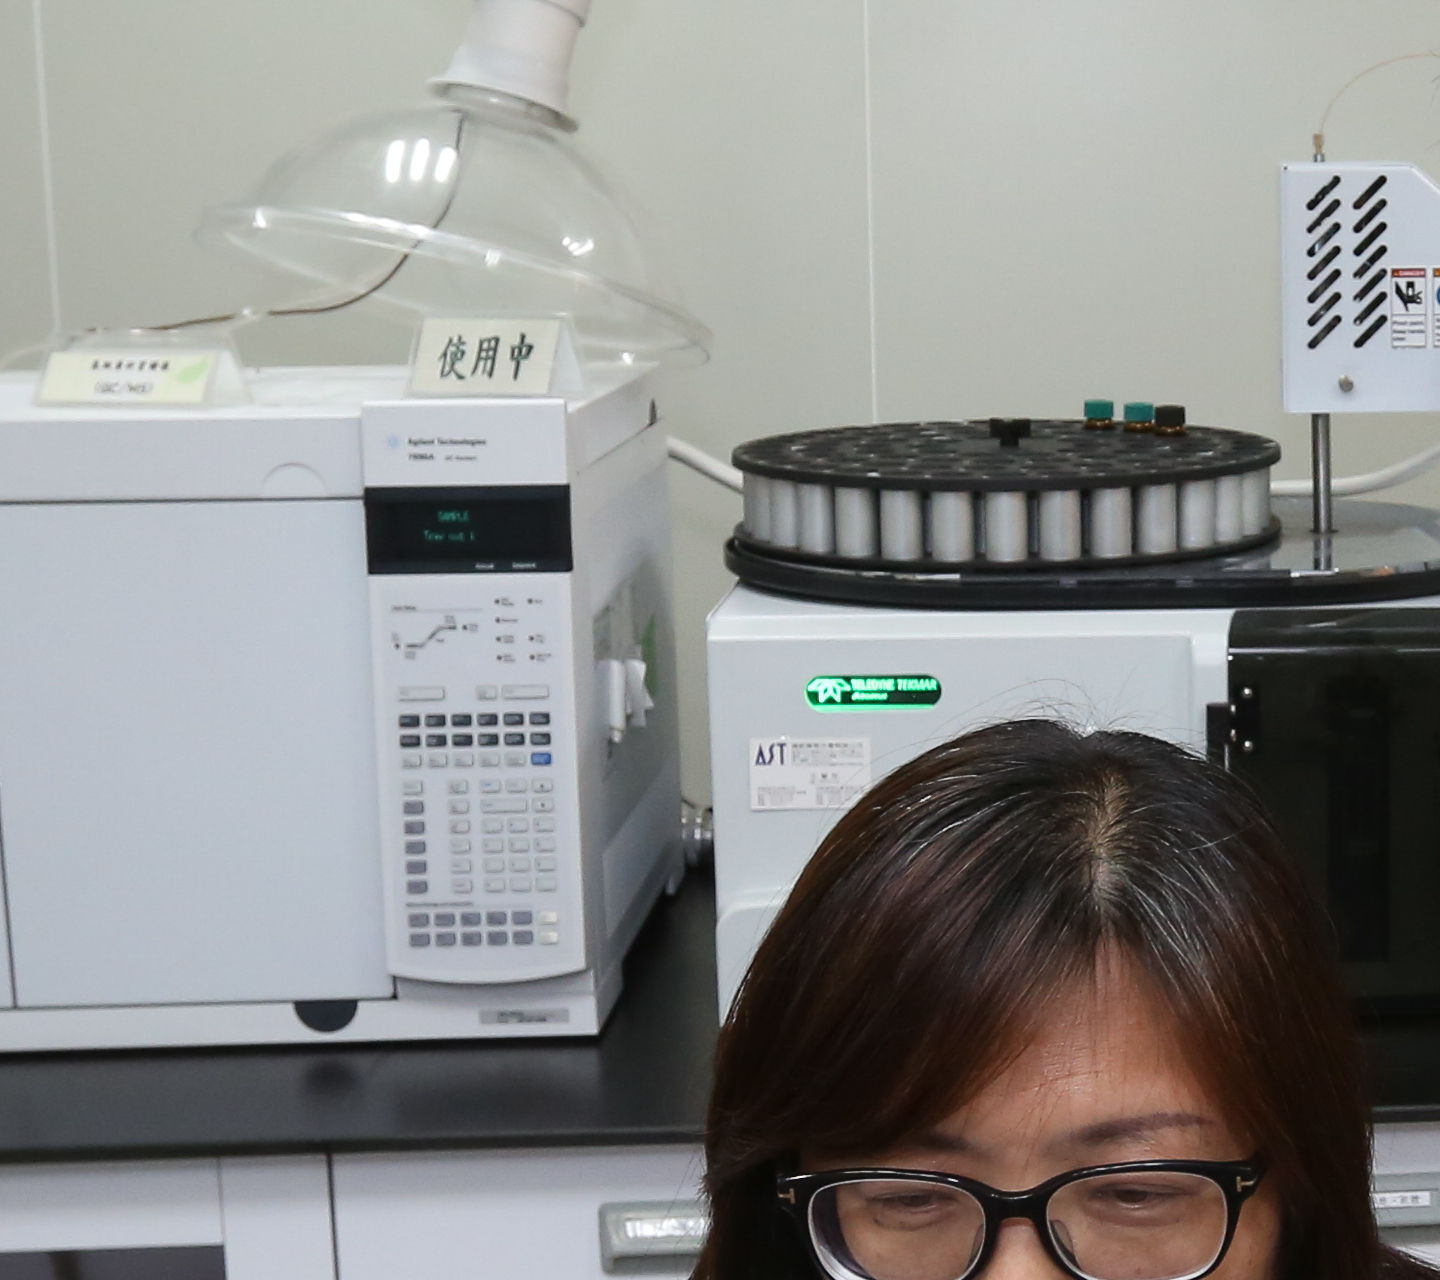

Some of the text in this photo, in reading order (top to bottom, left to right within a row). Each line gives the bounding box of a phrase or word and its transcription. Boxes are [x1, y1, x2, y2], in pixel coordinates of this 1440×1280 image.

[438, 332, 534, 381] 使用中
[851, 677, 938, 691] TELEDYNE TEKMAR
[755, 742, 787, 766] AST
